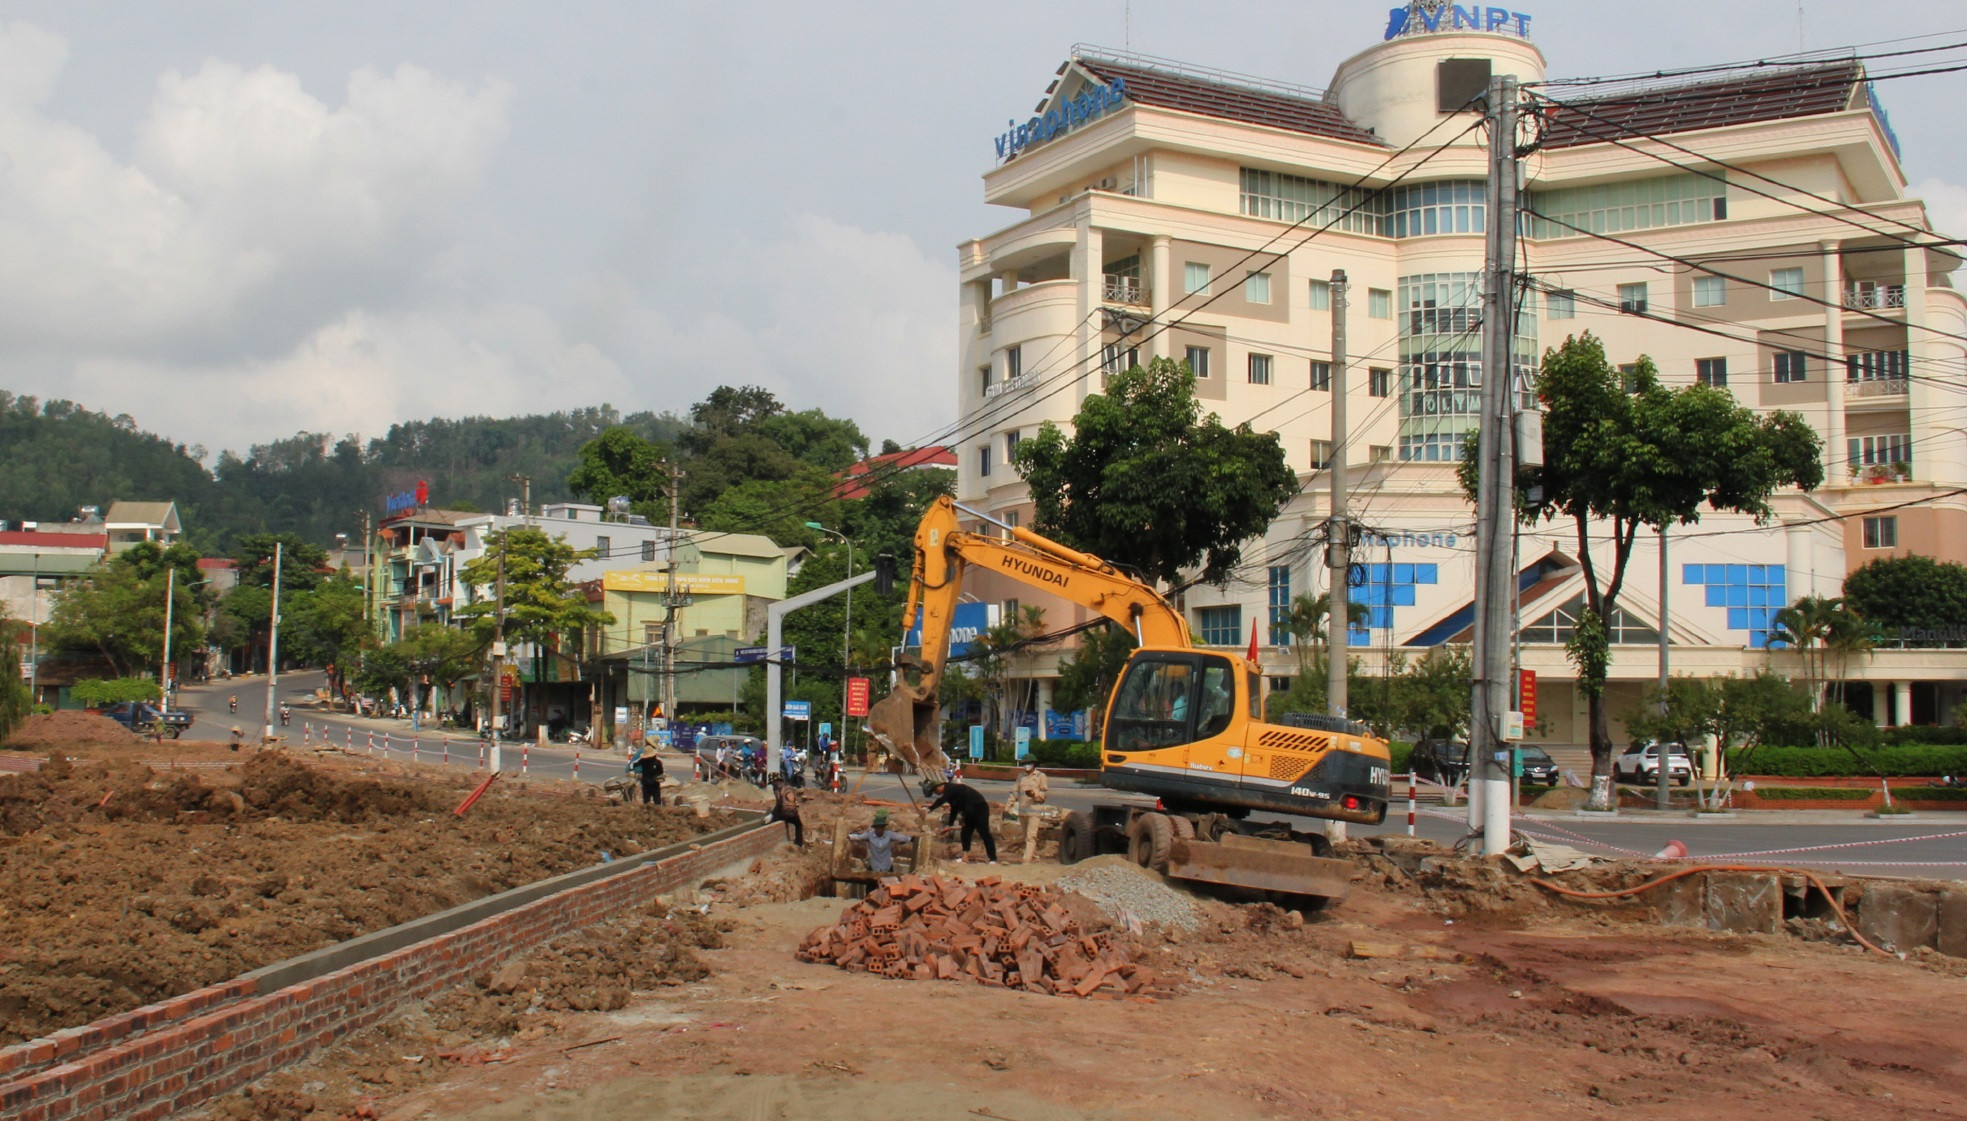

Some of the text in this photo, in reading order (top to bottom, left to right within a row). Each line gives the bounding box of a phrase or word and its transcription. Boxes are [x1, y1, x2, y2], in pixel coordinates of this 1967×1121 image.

[1418, 5, 1531, 37] VNPT
[994, 76, 1125, 159] vinaphone
[1002, 555, 1069, 588] HYUNDAI
